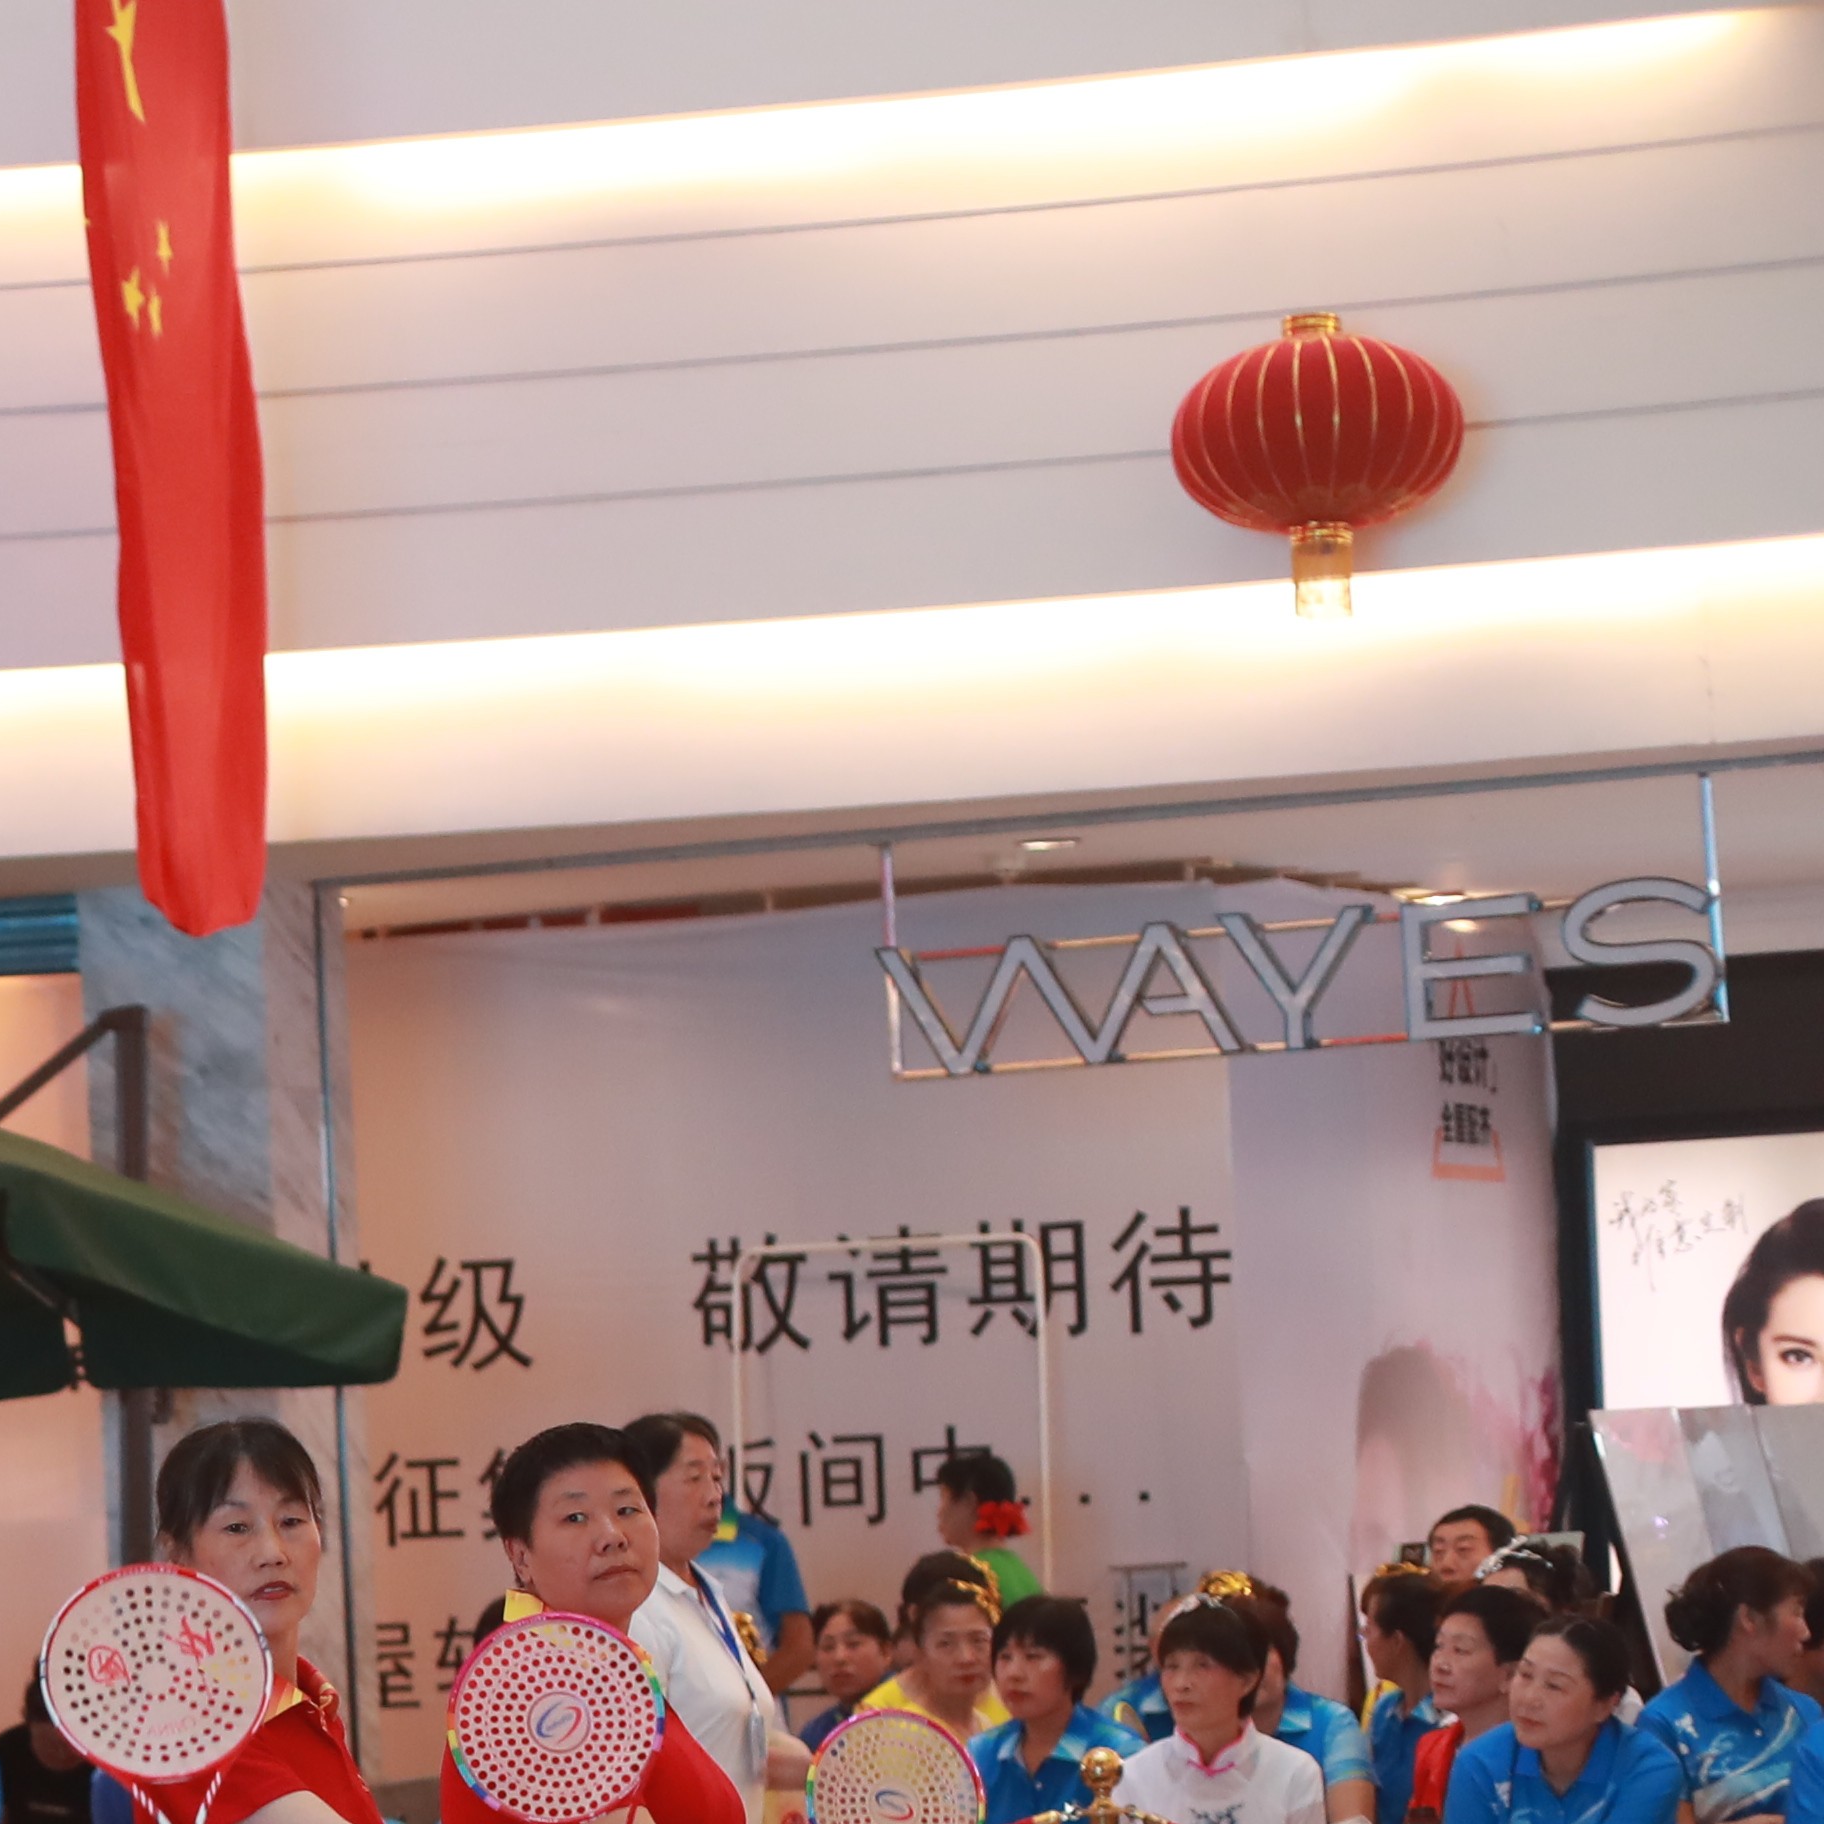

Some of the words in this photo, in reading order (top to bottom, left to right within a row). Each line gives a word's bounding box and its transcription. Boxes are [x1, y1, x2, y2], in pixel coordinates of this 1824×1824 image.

[875, 876, 1720, 1075] WAYES
[690, 1205, 1233, 1355] 敬请期待
